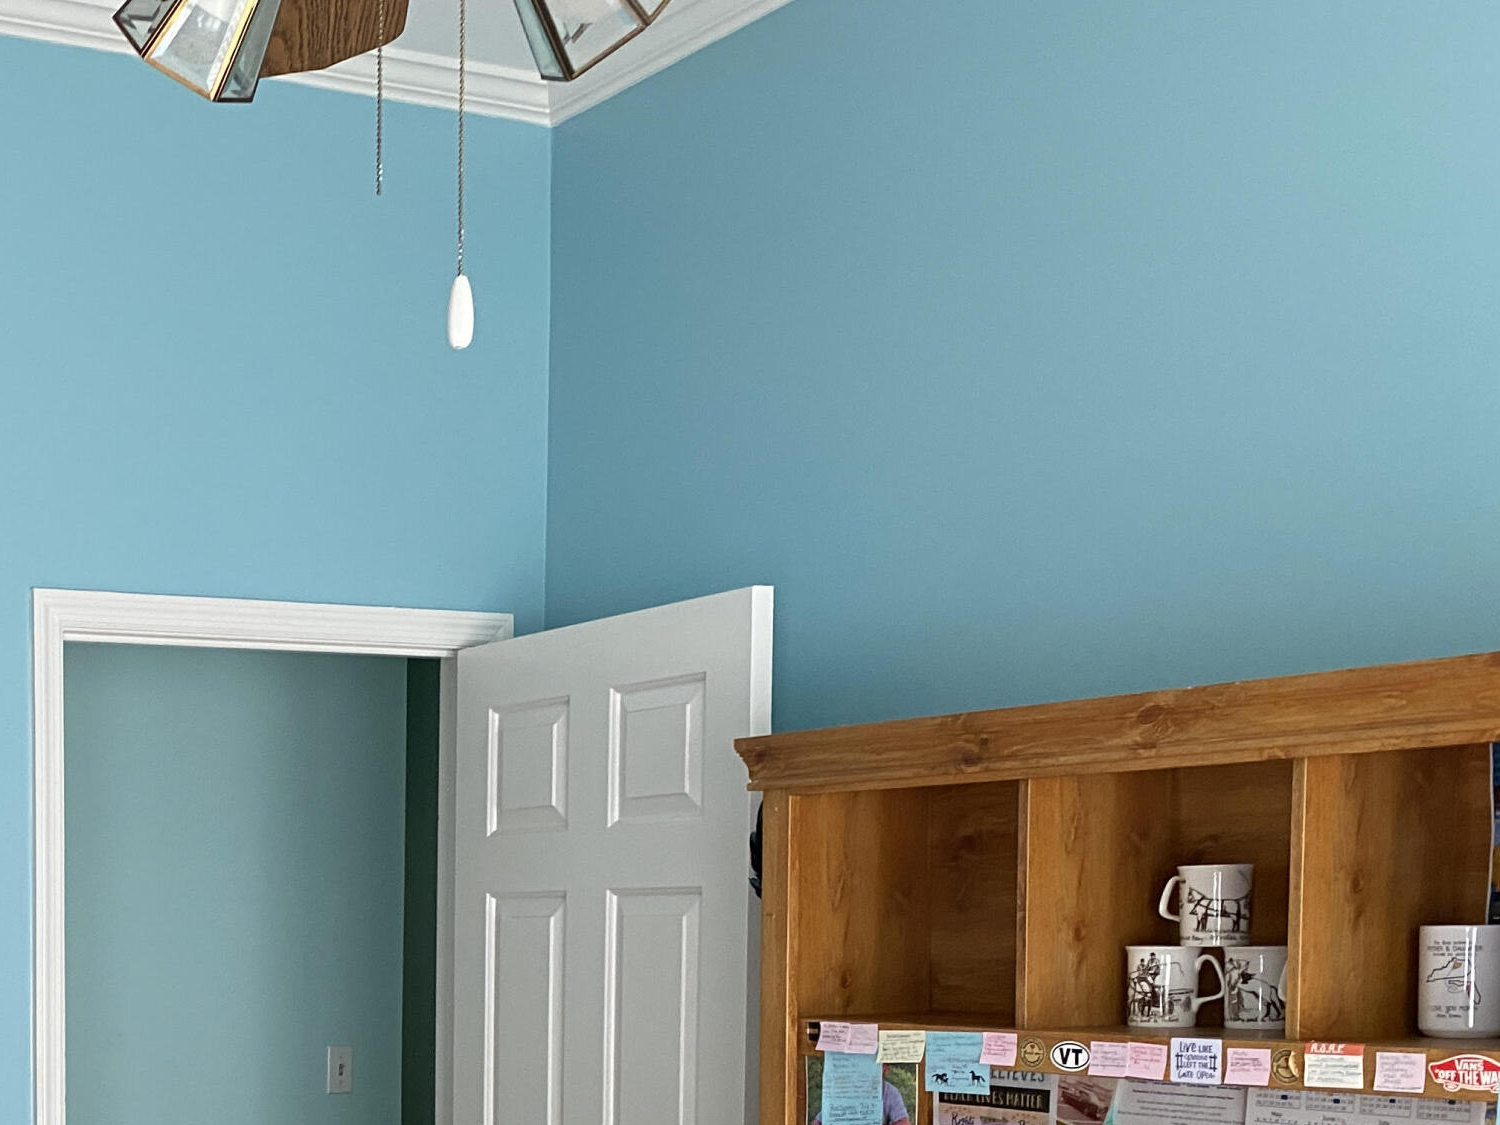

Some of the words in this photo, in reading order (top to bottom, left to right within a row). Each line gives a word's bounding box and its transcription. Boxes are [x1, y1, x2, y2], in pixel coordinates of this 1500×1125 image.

[1179, 1041, 1197, 1053] Live
[1059, 1047, 1083, 1066] VT
[1454, 1059, 1485, 1071] VANS
[1457, 1070, 1481, 1085] THE
[1006, 1093, 1044, 1109] MATTER
